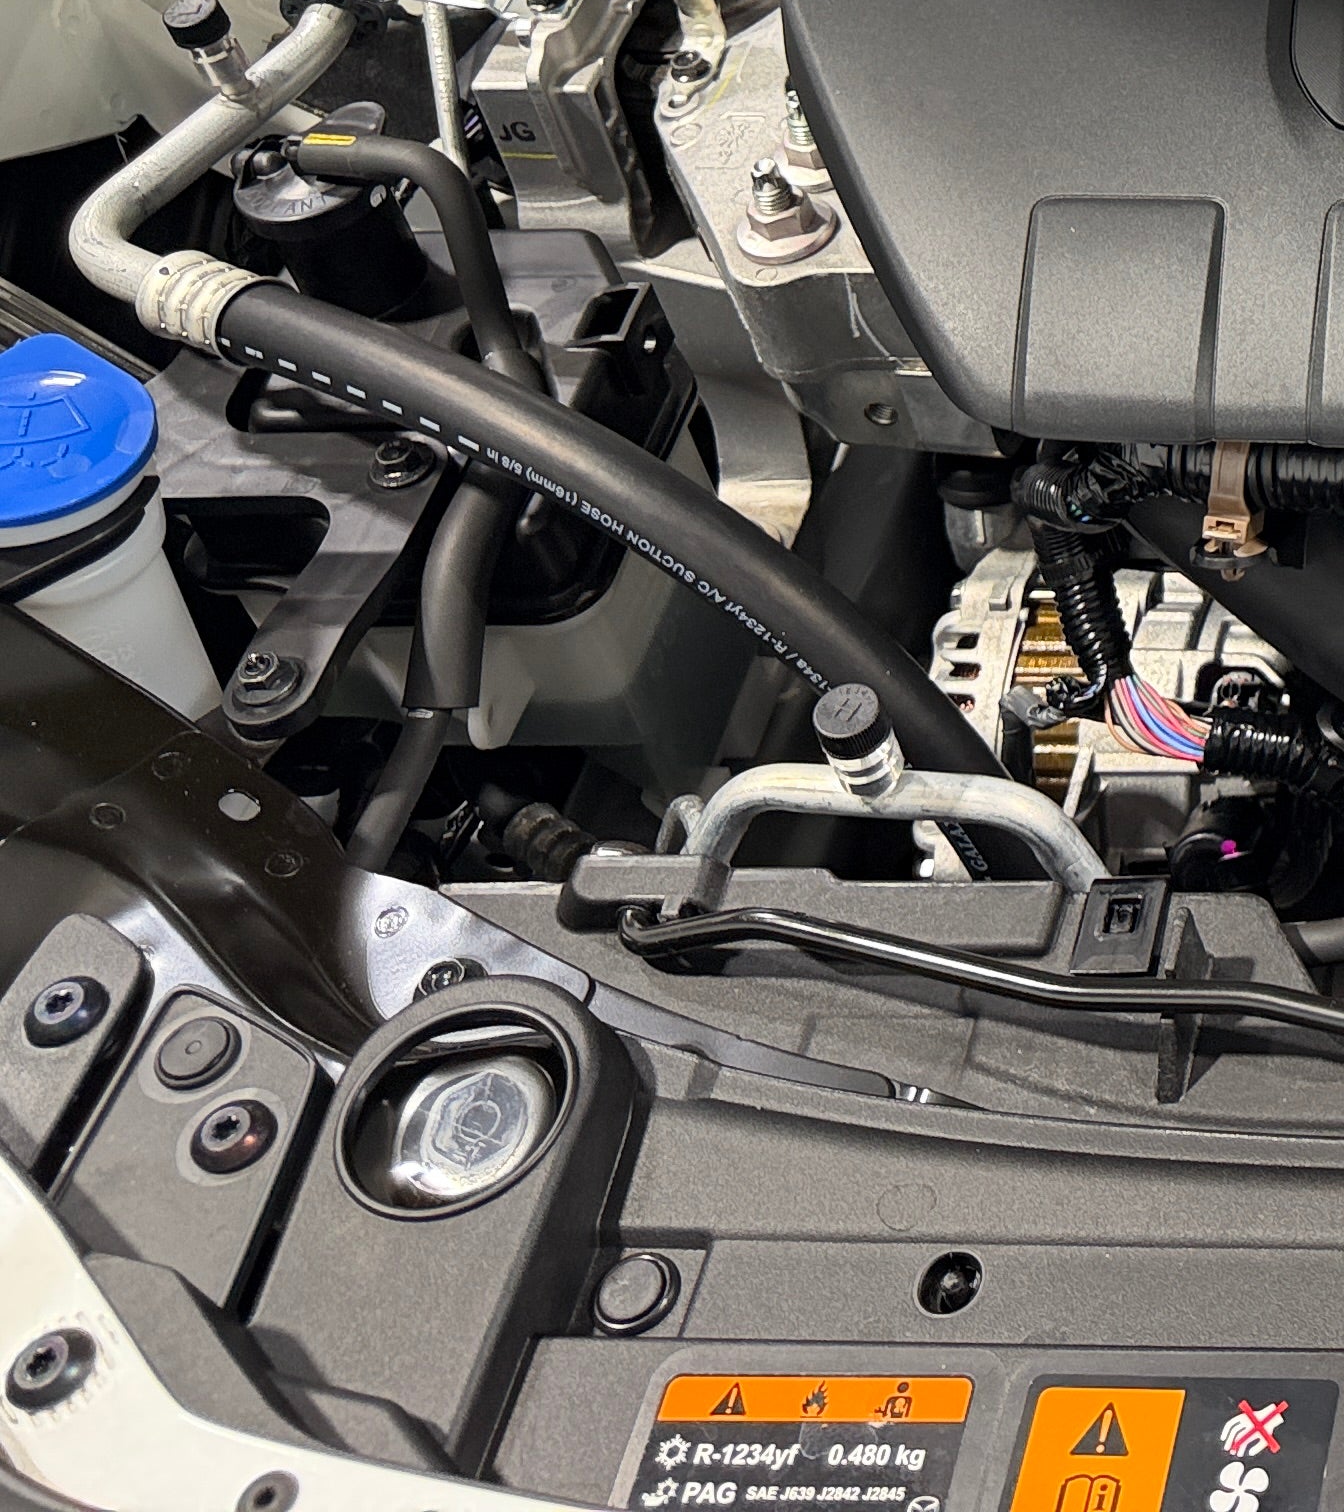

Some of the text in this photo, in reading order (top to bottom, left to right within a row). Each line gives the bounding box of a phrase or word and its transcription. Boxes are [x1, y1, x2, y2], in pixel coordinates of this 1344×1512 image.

[500, 121, 536, 142] JG
[501, 455, 523, 476] 5/8
[525, 466, 578, 506] (16mm)
[580, 500, 624, 536] HOSE
[626, 529, 696, 583] SUCTION
[698, 579, 726, 604] A/C
[724, 601, 788, 654] R-1234yf
[797, 658, 832, 691] -134a
[693, 1443, 926, 1470] R-1234yf 0.480 kg
[681, 1481, 906, 1504] PAG SAE J639 J2842 J2845
